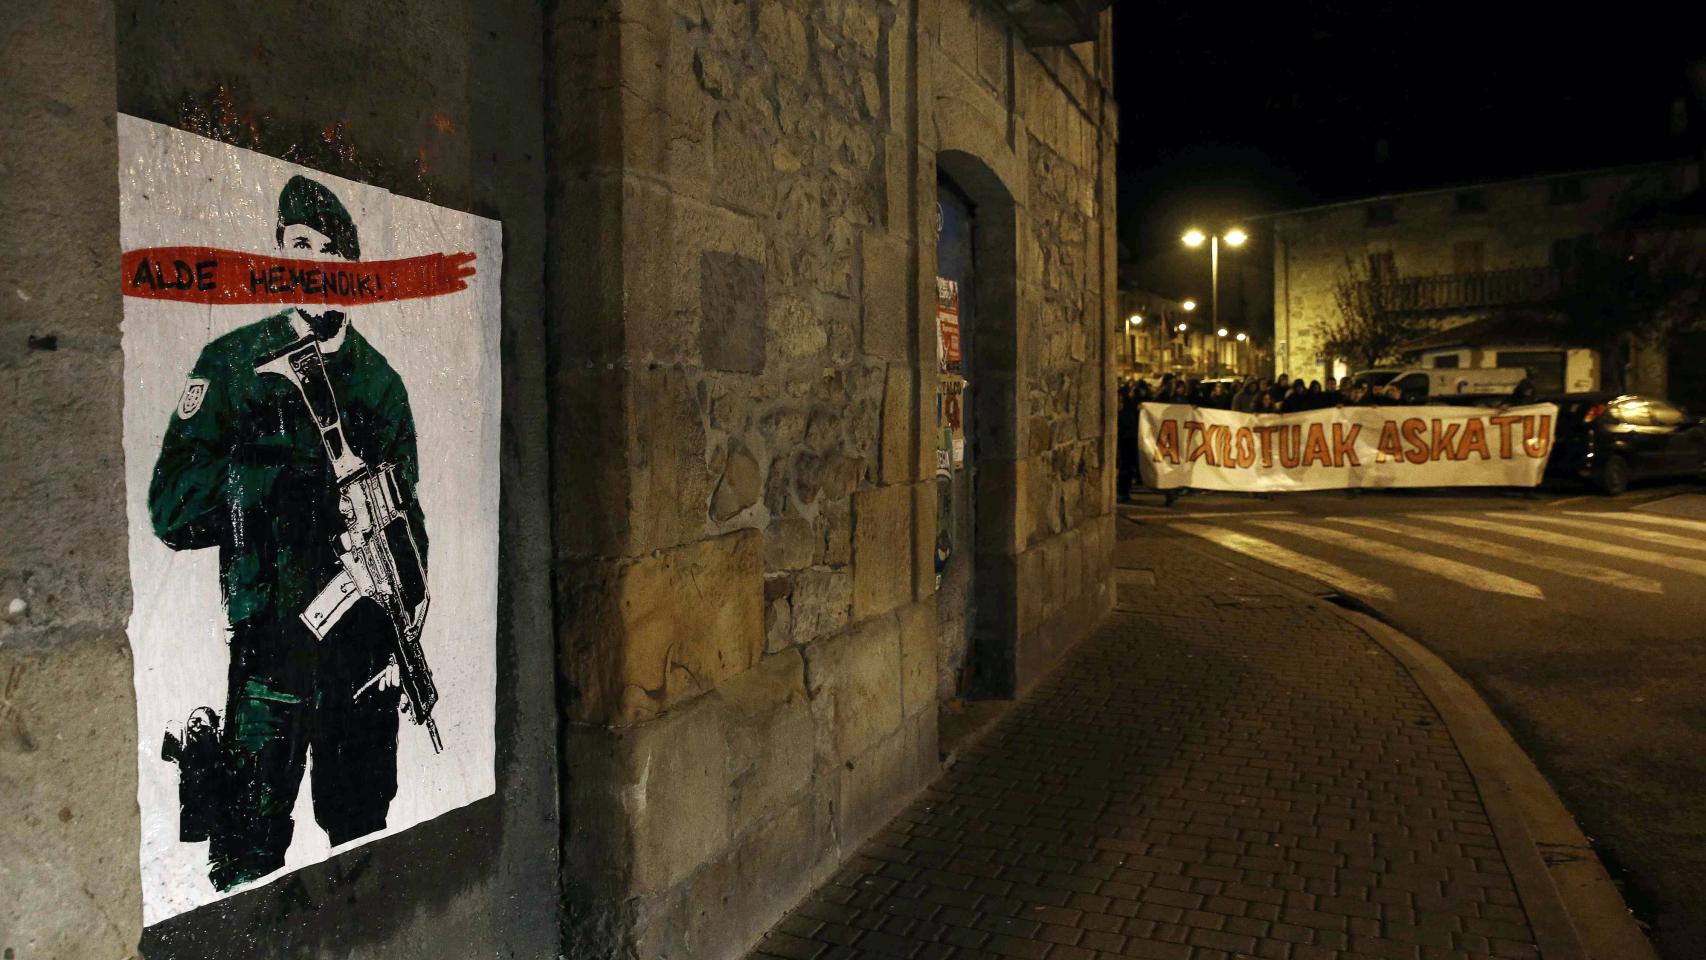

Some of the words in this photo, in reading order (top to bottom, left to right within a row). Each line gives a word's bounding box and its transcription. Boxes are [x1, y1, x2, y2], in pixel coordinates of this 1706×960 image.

[132, 257, 218, 291] ALDE
[250, 265, 385, 299] HEMENDIK!
[1153, 419, 1362, 469] ATXILOTUAK
[1376, 414, 1551, 465] ASKATU
